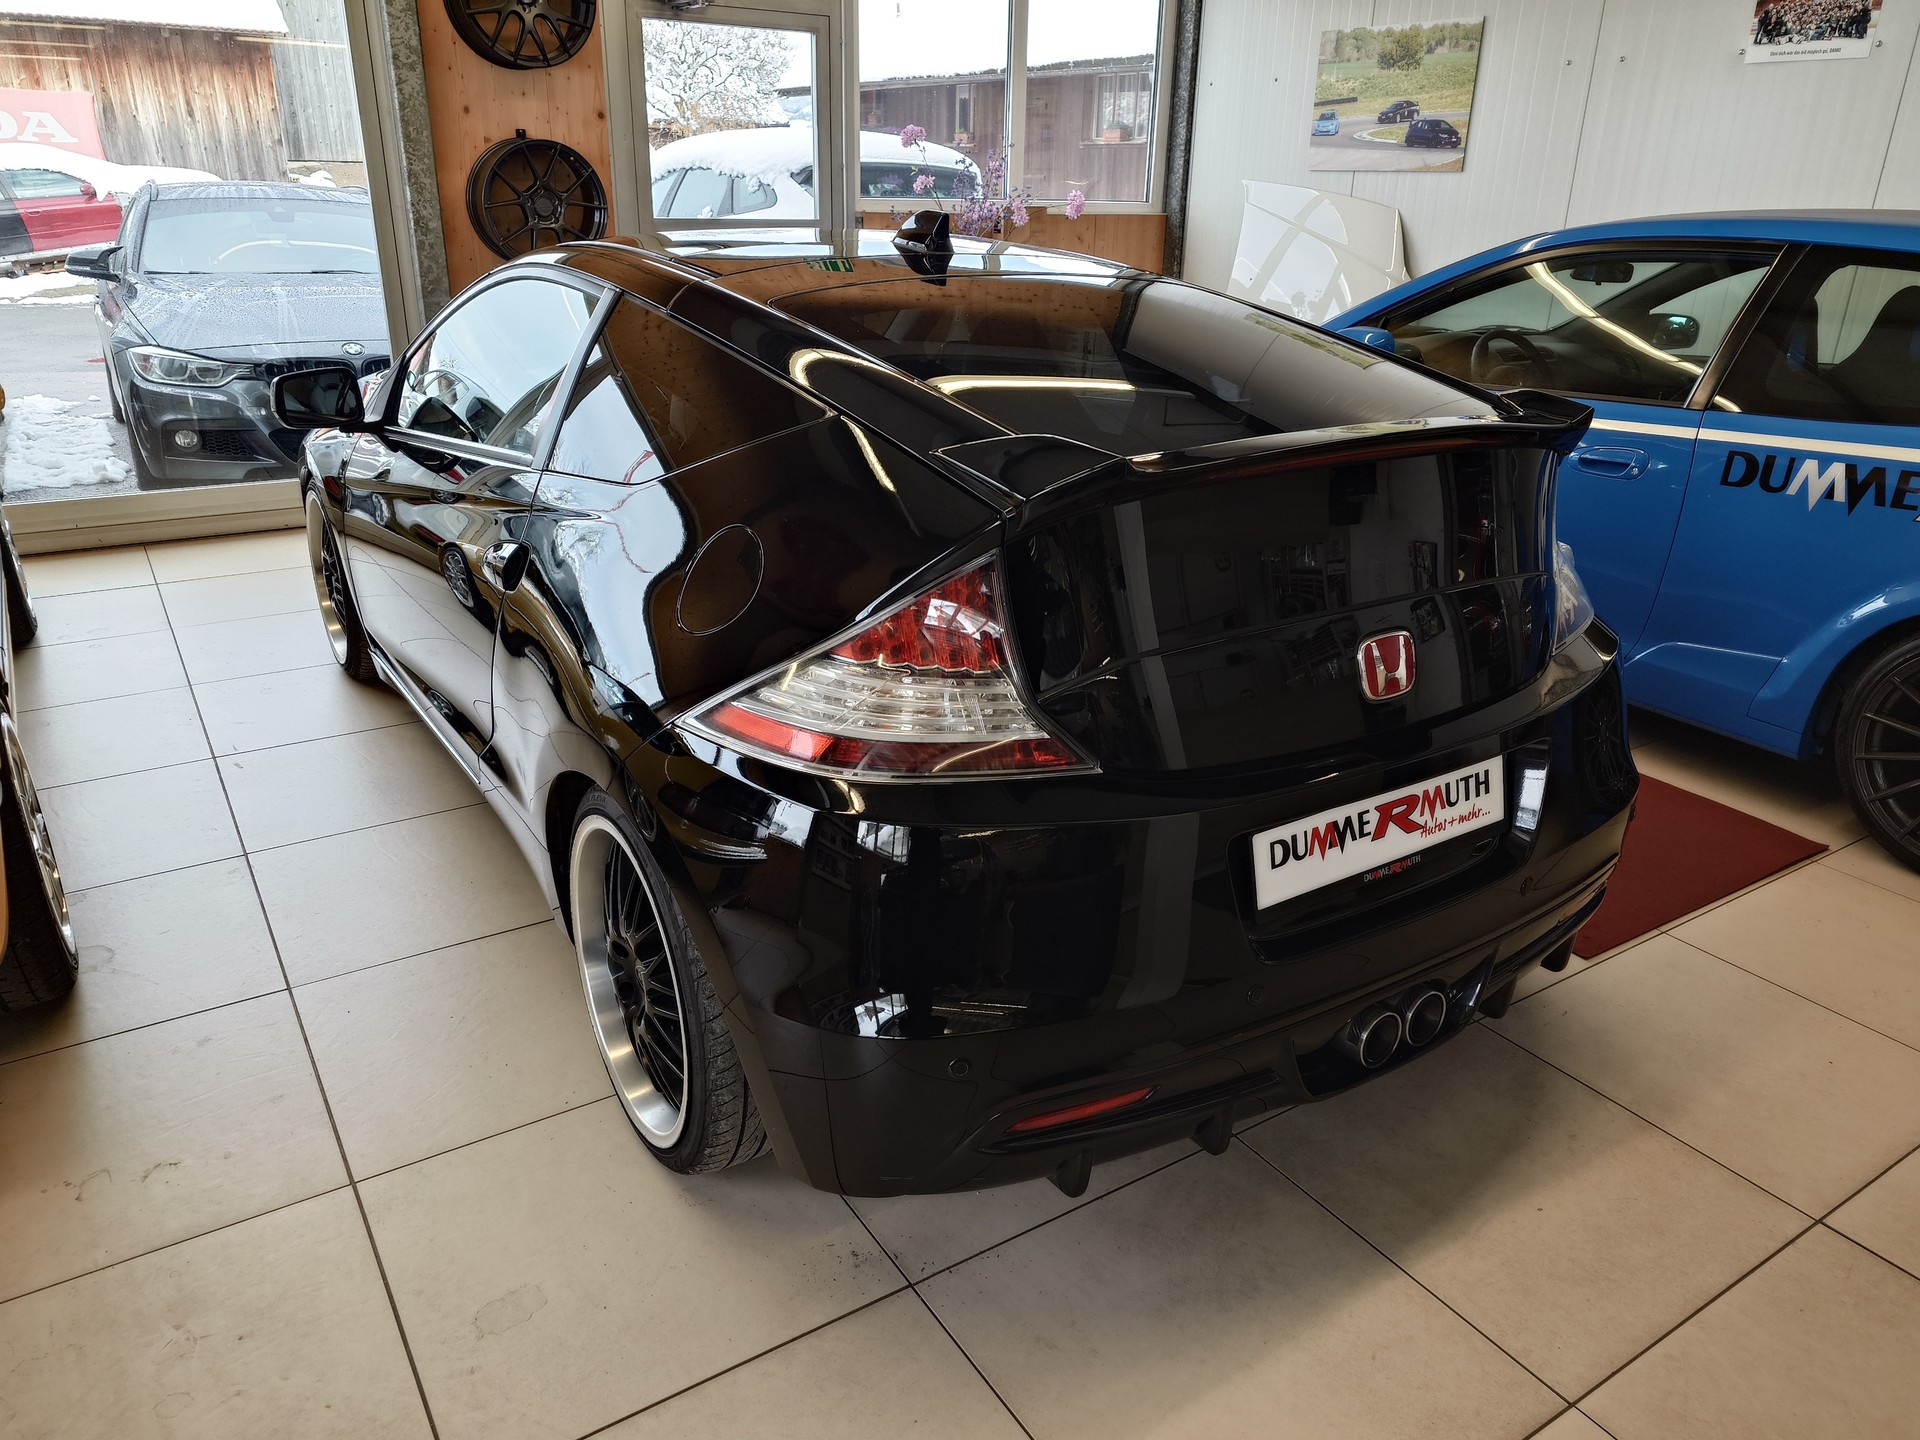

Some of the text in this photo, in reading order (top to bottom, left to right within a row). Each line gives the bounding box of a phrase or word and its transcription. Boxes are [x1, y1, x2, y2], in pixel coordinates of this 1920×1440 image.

[1719, 449, 1920, 518] DUMME
[1270, 768, 1490, 870] DUMMERMUTH
[1363, 854, 1421, 883] DUMMERMUTH
